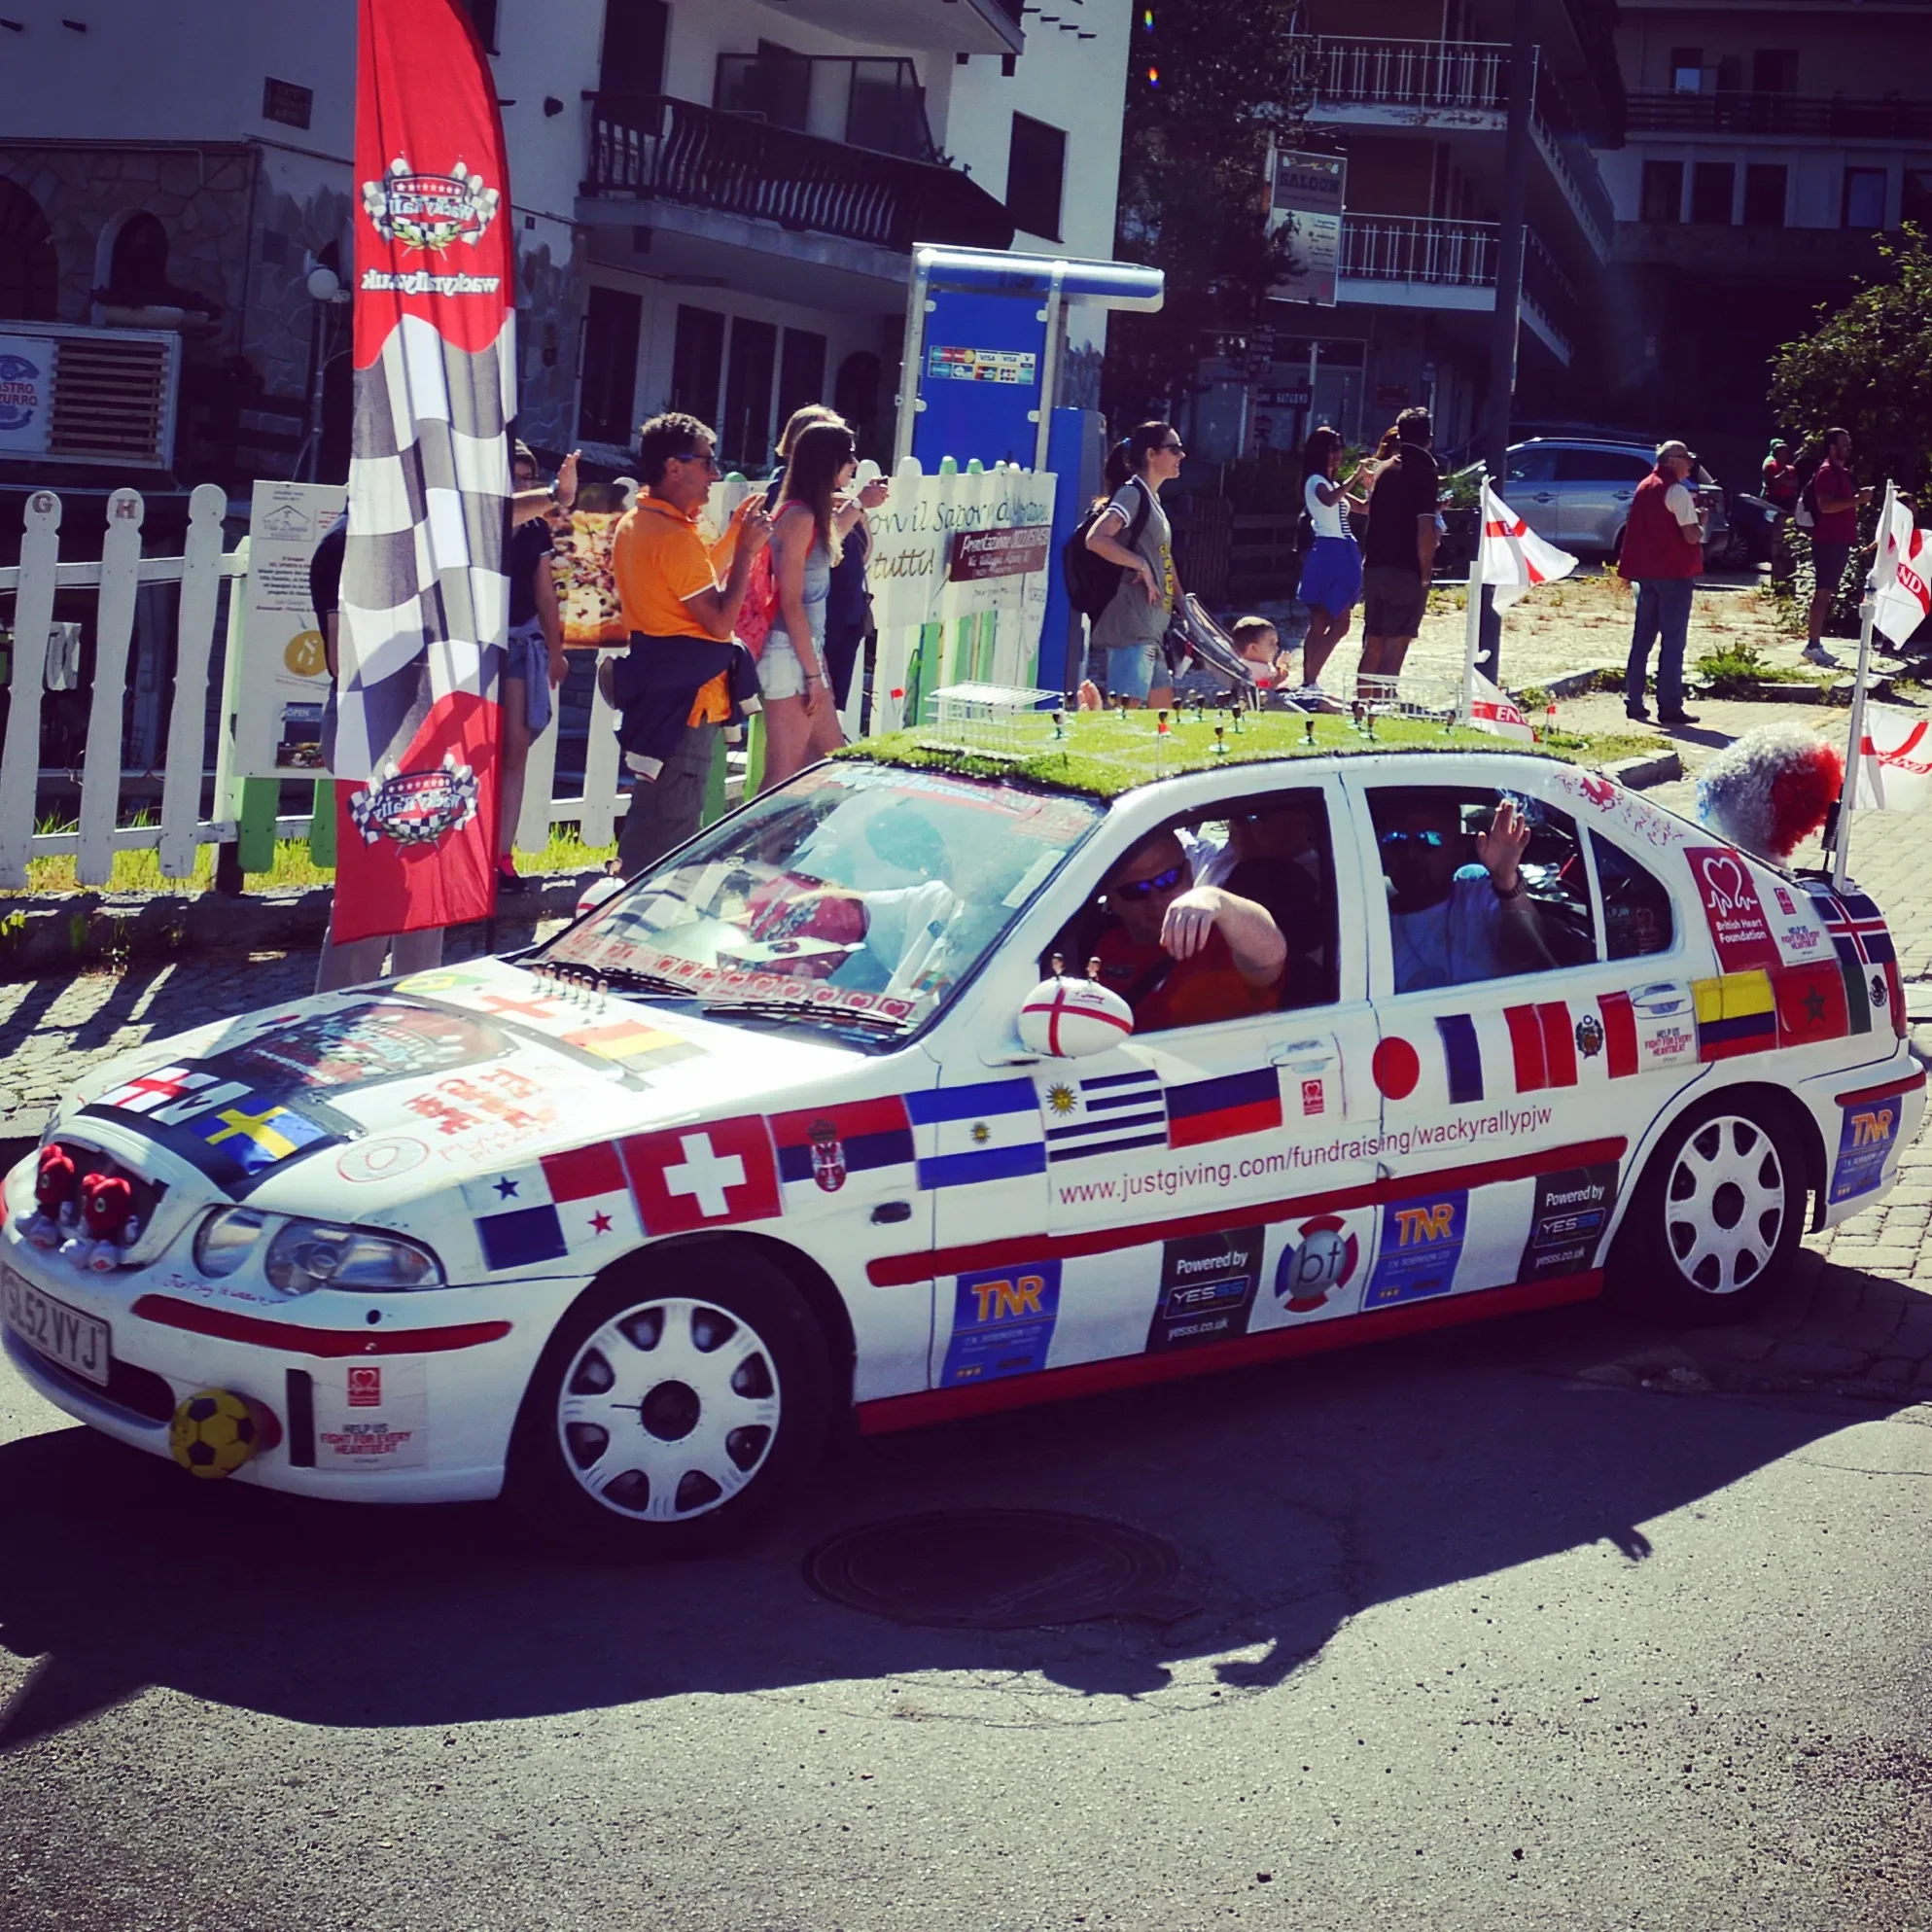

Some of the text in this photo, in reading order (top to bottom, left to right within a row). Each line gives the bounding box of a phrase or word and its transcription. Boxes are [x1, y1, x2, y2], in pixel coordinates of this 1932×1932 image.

[32, 493, 53, 513] G
[116, 498, 137, 519] H
[1715, 918, 1764, 931] British Heart
[1719, 930, 1768, 943] Foundation
[1851, 1108, 1893, 1147] TNR
[1059, 1105, 1553, 1205] www.justgiving.com/fundraising/wackyrallypjw
[1546, 1184, 1605, 1208] Powered by
[1395, 1203, 1456, 1247] TNR
[1177, 1250, 1249, 1275] Powered by
[971, 1275, 1045, 1322] TNR
[52, 1306, 97, 1370] VYJ
